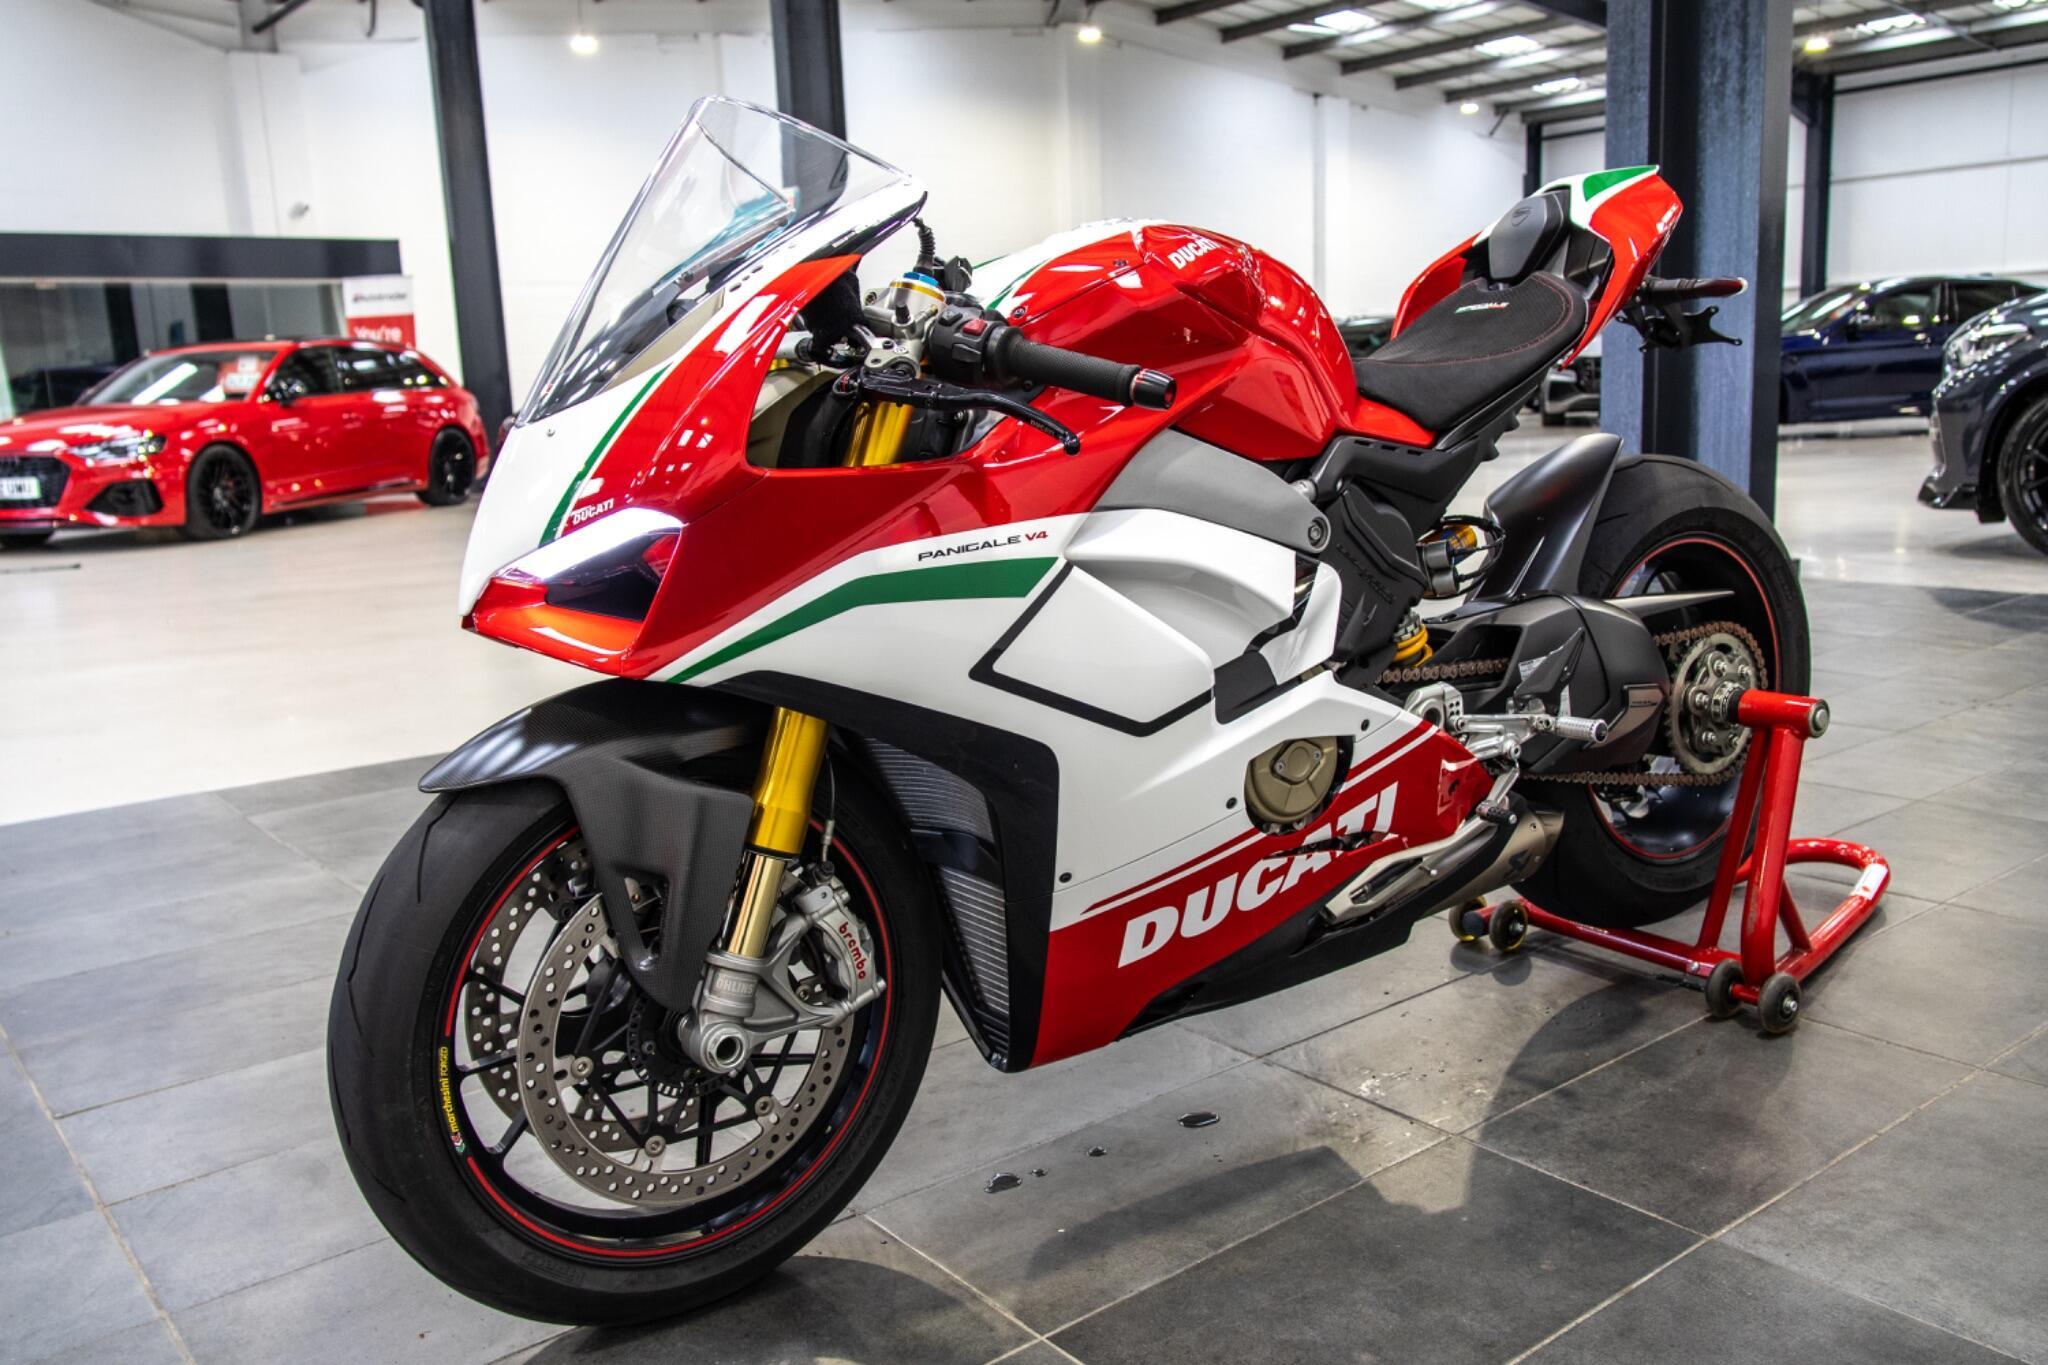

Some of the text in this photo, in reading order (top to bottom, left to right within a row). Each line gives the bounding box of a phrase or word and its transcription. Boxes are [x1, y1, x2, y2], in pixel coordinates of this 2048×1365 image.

[572, 498, 614, 525] DUCATI
[918, 530, 1048, 562] PANIGALE V4
[1117, 780, 1399, 969] DUCATI
[838, 921, 867, 980] brembo
[439, 1046, 460, 1133] marchesini FORGED
